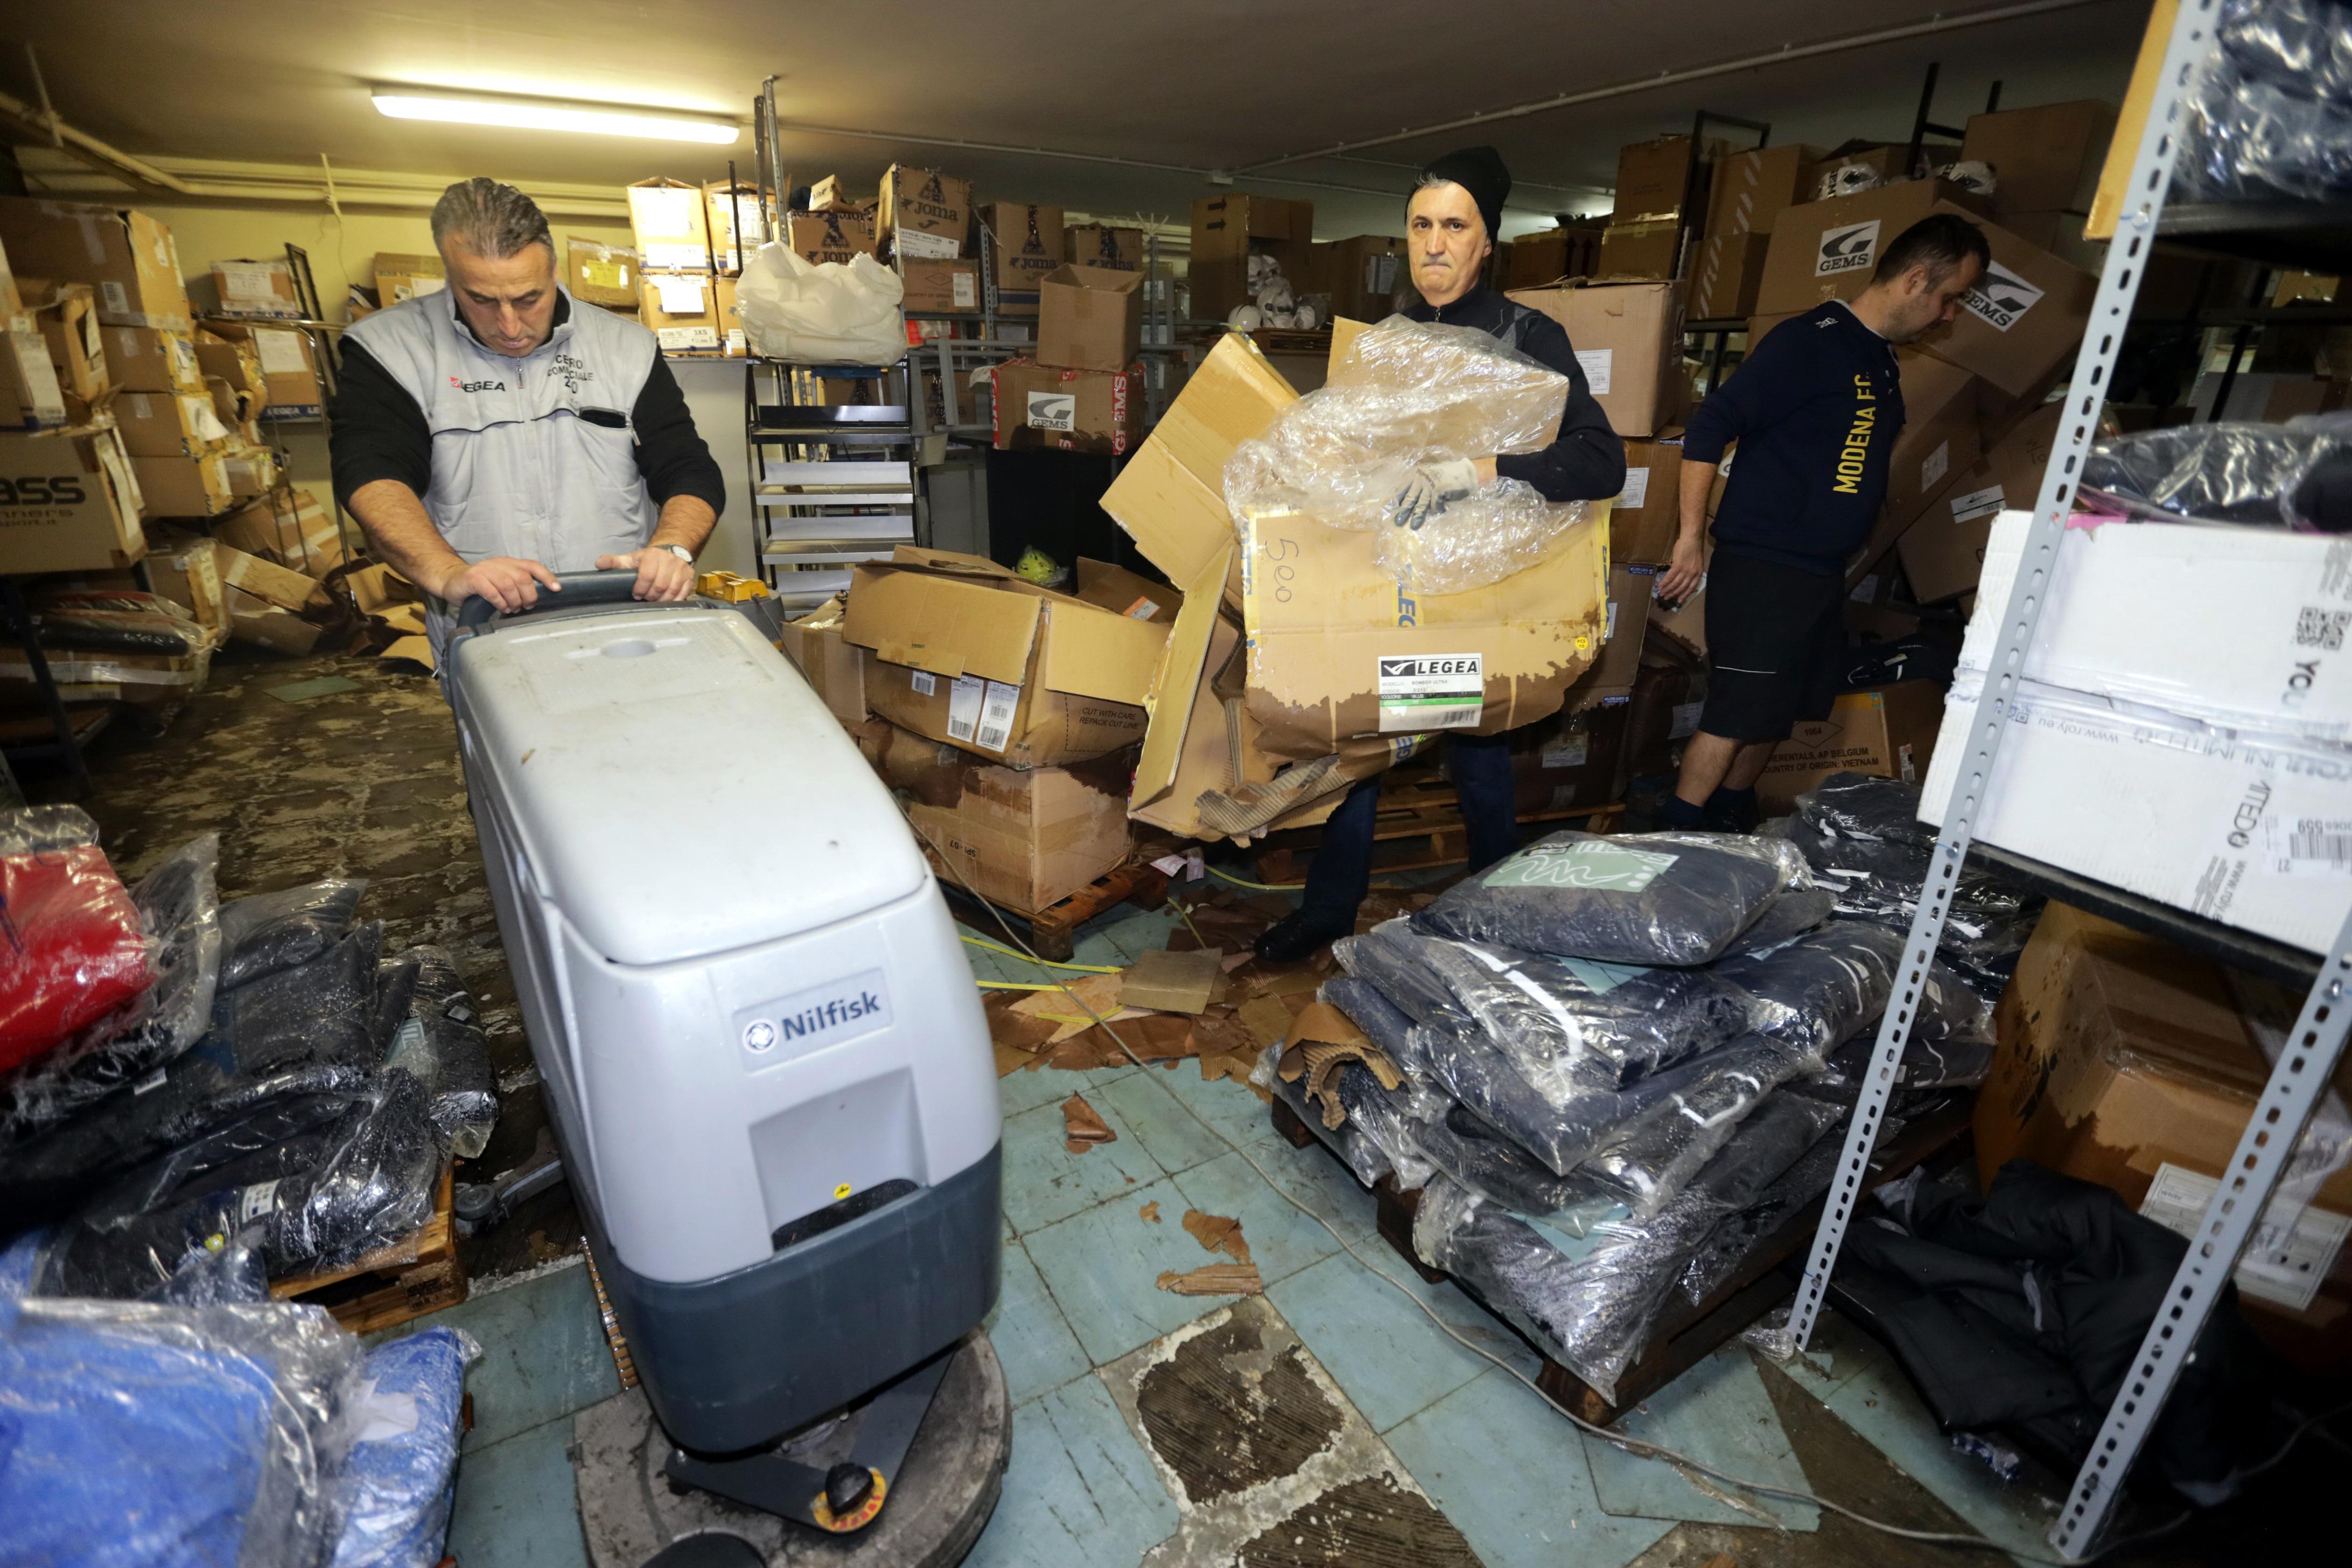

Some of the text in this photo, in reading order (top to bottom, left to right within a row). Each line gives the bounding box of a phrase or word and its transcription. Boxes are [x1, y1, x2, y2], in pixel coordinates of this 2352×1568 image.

[1819, 253, 1870, 271] GEMS
[1966, 288, 2013, 327] EMS
[460, 381, 506, 393] LEGEA
[1032, 418, 1068, 430] GEMS
[1833, 407, 1876, 494] MODENA
[1417, 660, 1478, 674] LEGEA
[1079, 717, 1108, 726] REPACK
[1117, 712, 1137, 720] CARE
[1804, 727, 1822, 736] 1064
[2039, 716, 2119, 744] www.roly.eu
[1831, 747, 1869, 758] BELGIUM
[1765, 758, 1879, 773] OUNTRY OF ORIGIN: VIETNAM
[782, 991, 881, 1042] Nilfisk
[2160, 1189, 2182, 1201] White
